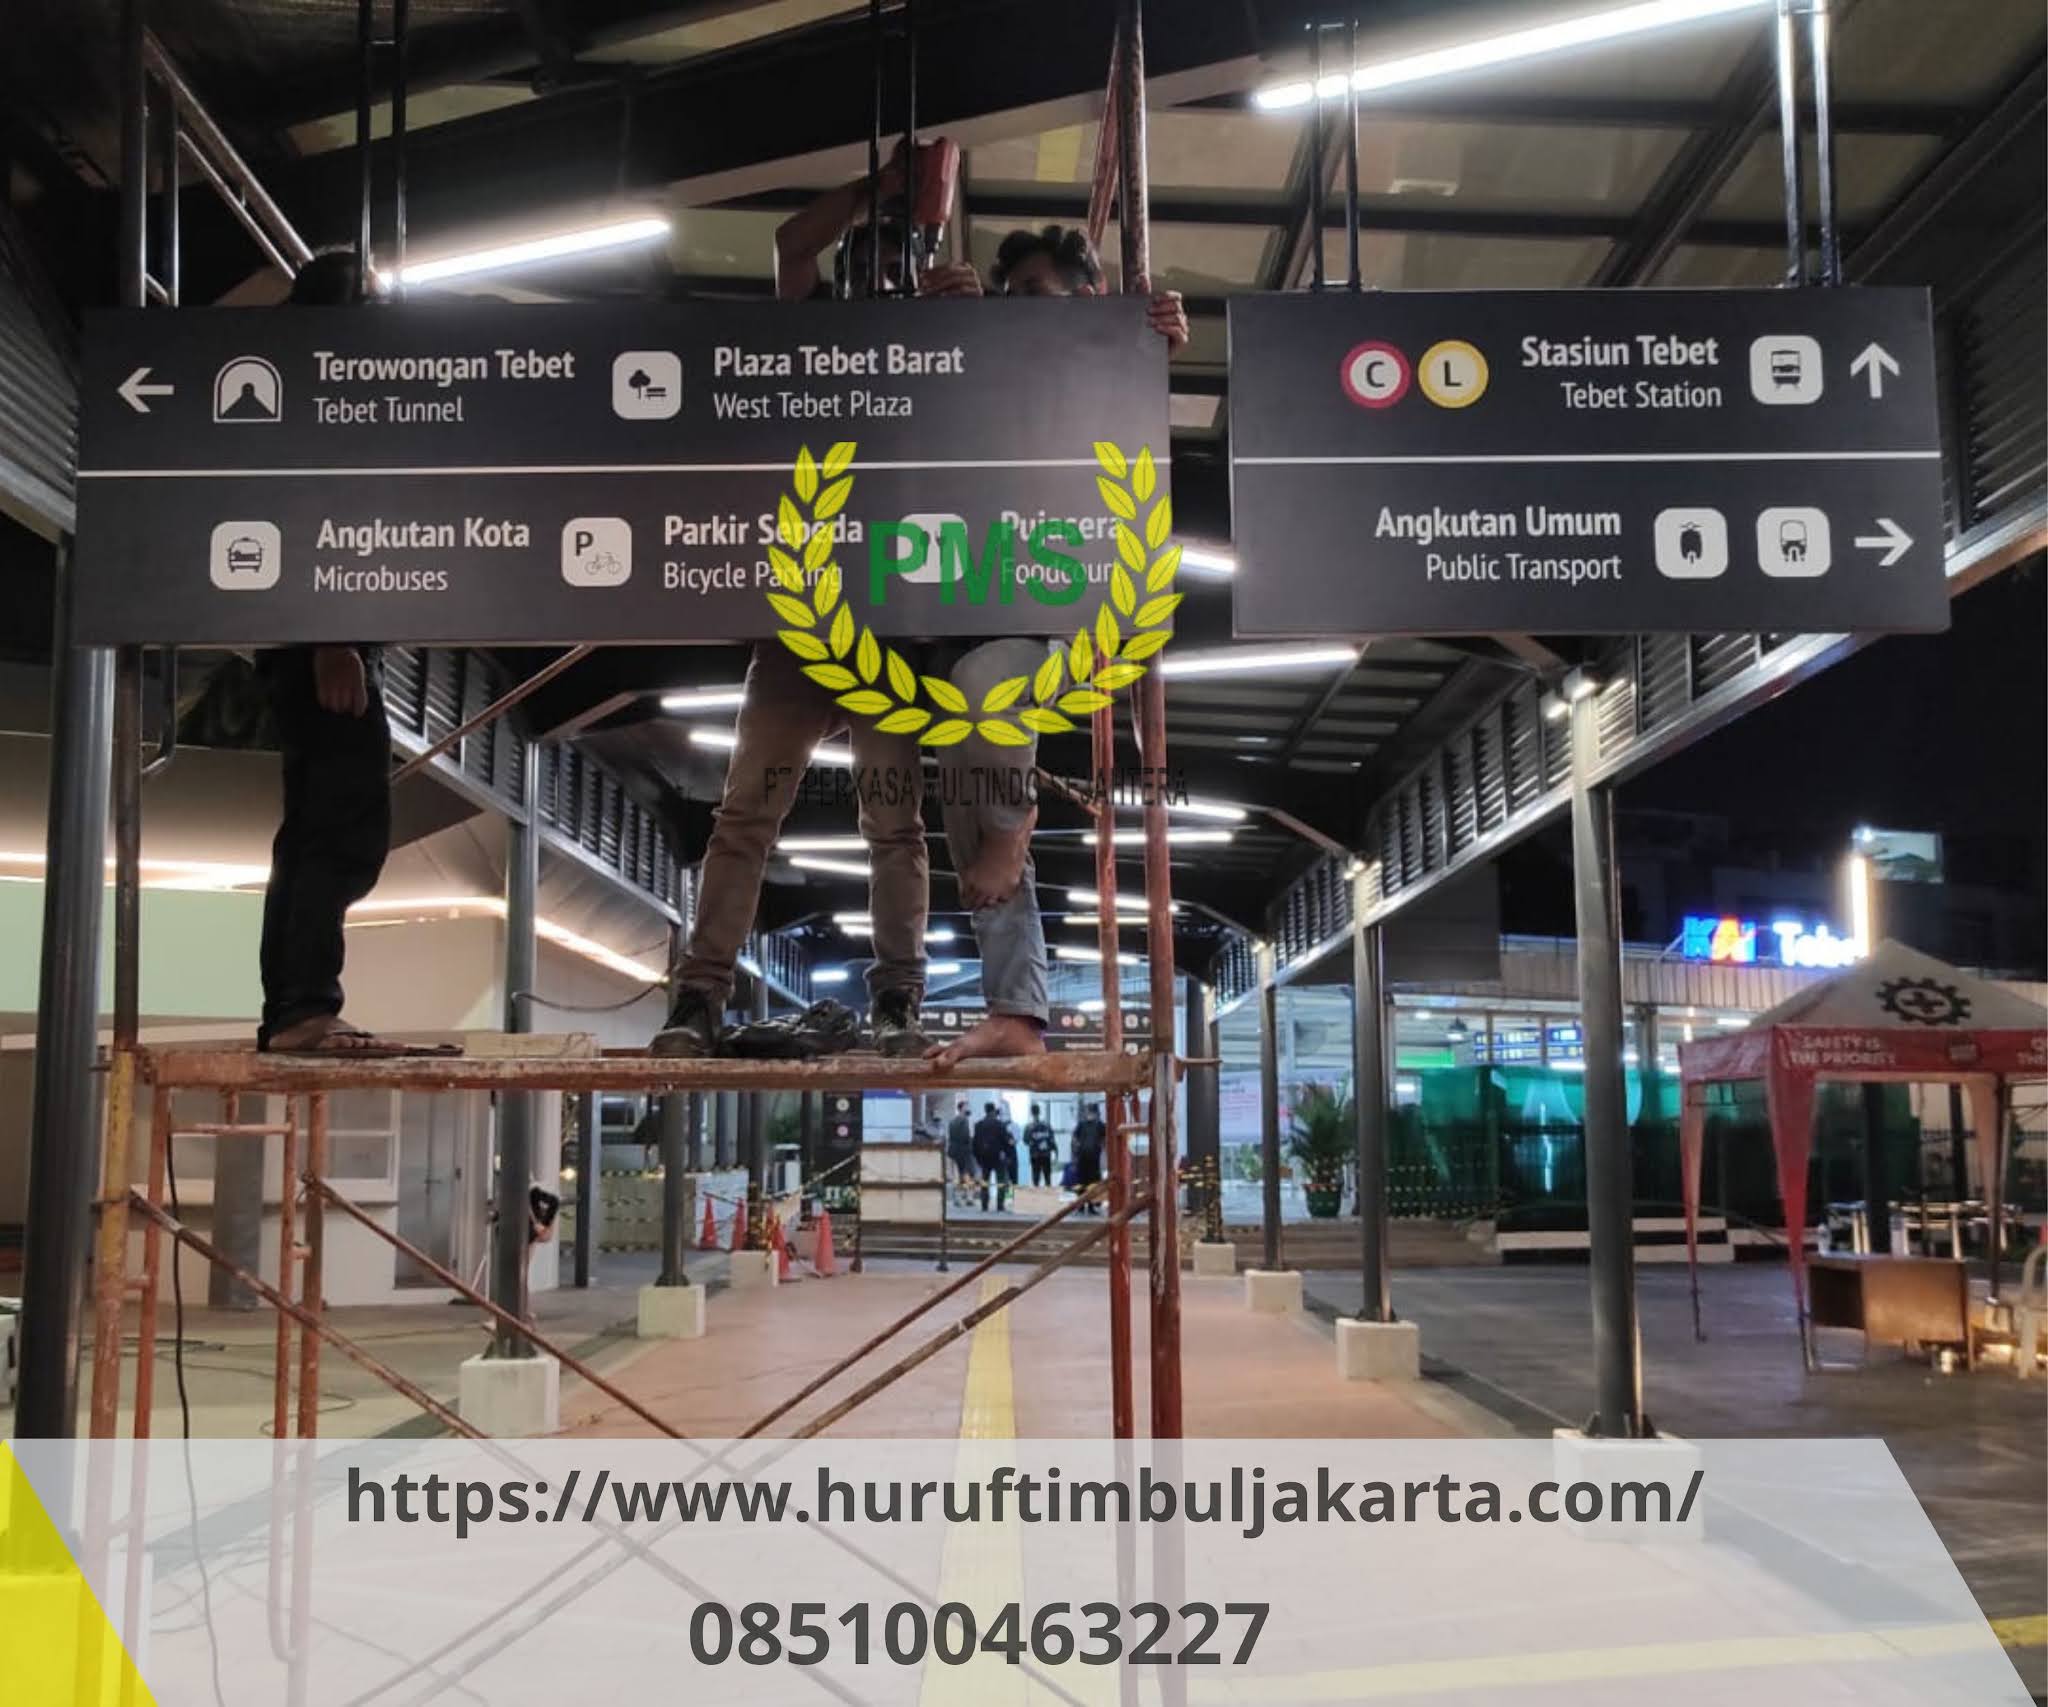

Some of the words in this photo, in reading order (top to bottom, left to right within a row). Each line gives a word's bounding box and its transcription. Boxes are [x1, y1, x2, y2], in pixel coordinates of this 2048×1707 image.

[714, 346, 792, 377] Plaza
[799, 346, 879, 375] Tebet
[887, 346, 964, 375] Barat
[1521, 335, 1630, 368] Stasiun
[1636, 335, 1719, 366] Tebet
[314, 351, 488, 388] Terowongan
[496, 350, 575, 379] Tebet
[1364, 360, 1387, 388] C
[1442, 361, 1462, 387] L
[314, 397, 375, 424] Tebet
[387, 396, 463, 423] Tunnel
[714, 393, 771, 420] West
[778, 391, 841, 418] Tebet
[850, 390, 913, 418] Plaza
[1561, 382, 1628, 409] Tebet
[1635, 381, 1722, 409] Station
[316, 519, 455, 556] Angkutan
[464, 518, 530, 548] Kota
[665, 515, 752, 547] Parkir
[1375, 507, 1516, 547] Angkutan
[1526, 506, 1621, 537] Umum
[574, 531, 594, 556] P
[315, 564, 448, 592] Microbuses
[664, 562, 746, 592] Bicycle
[1002, 559, 1122, 585] Foodcour
[1426, 553, 1500, 581] Public
[1507, 552, 1622, 586] Transport
